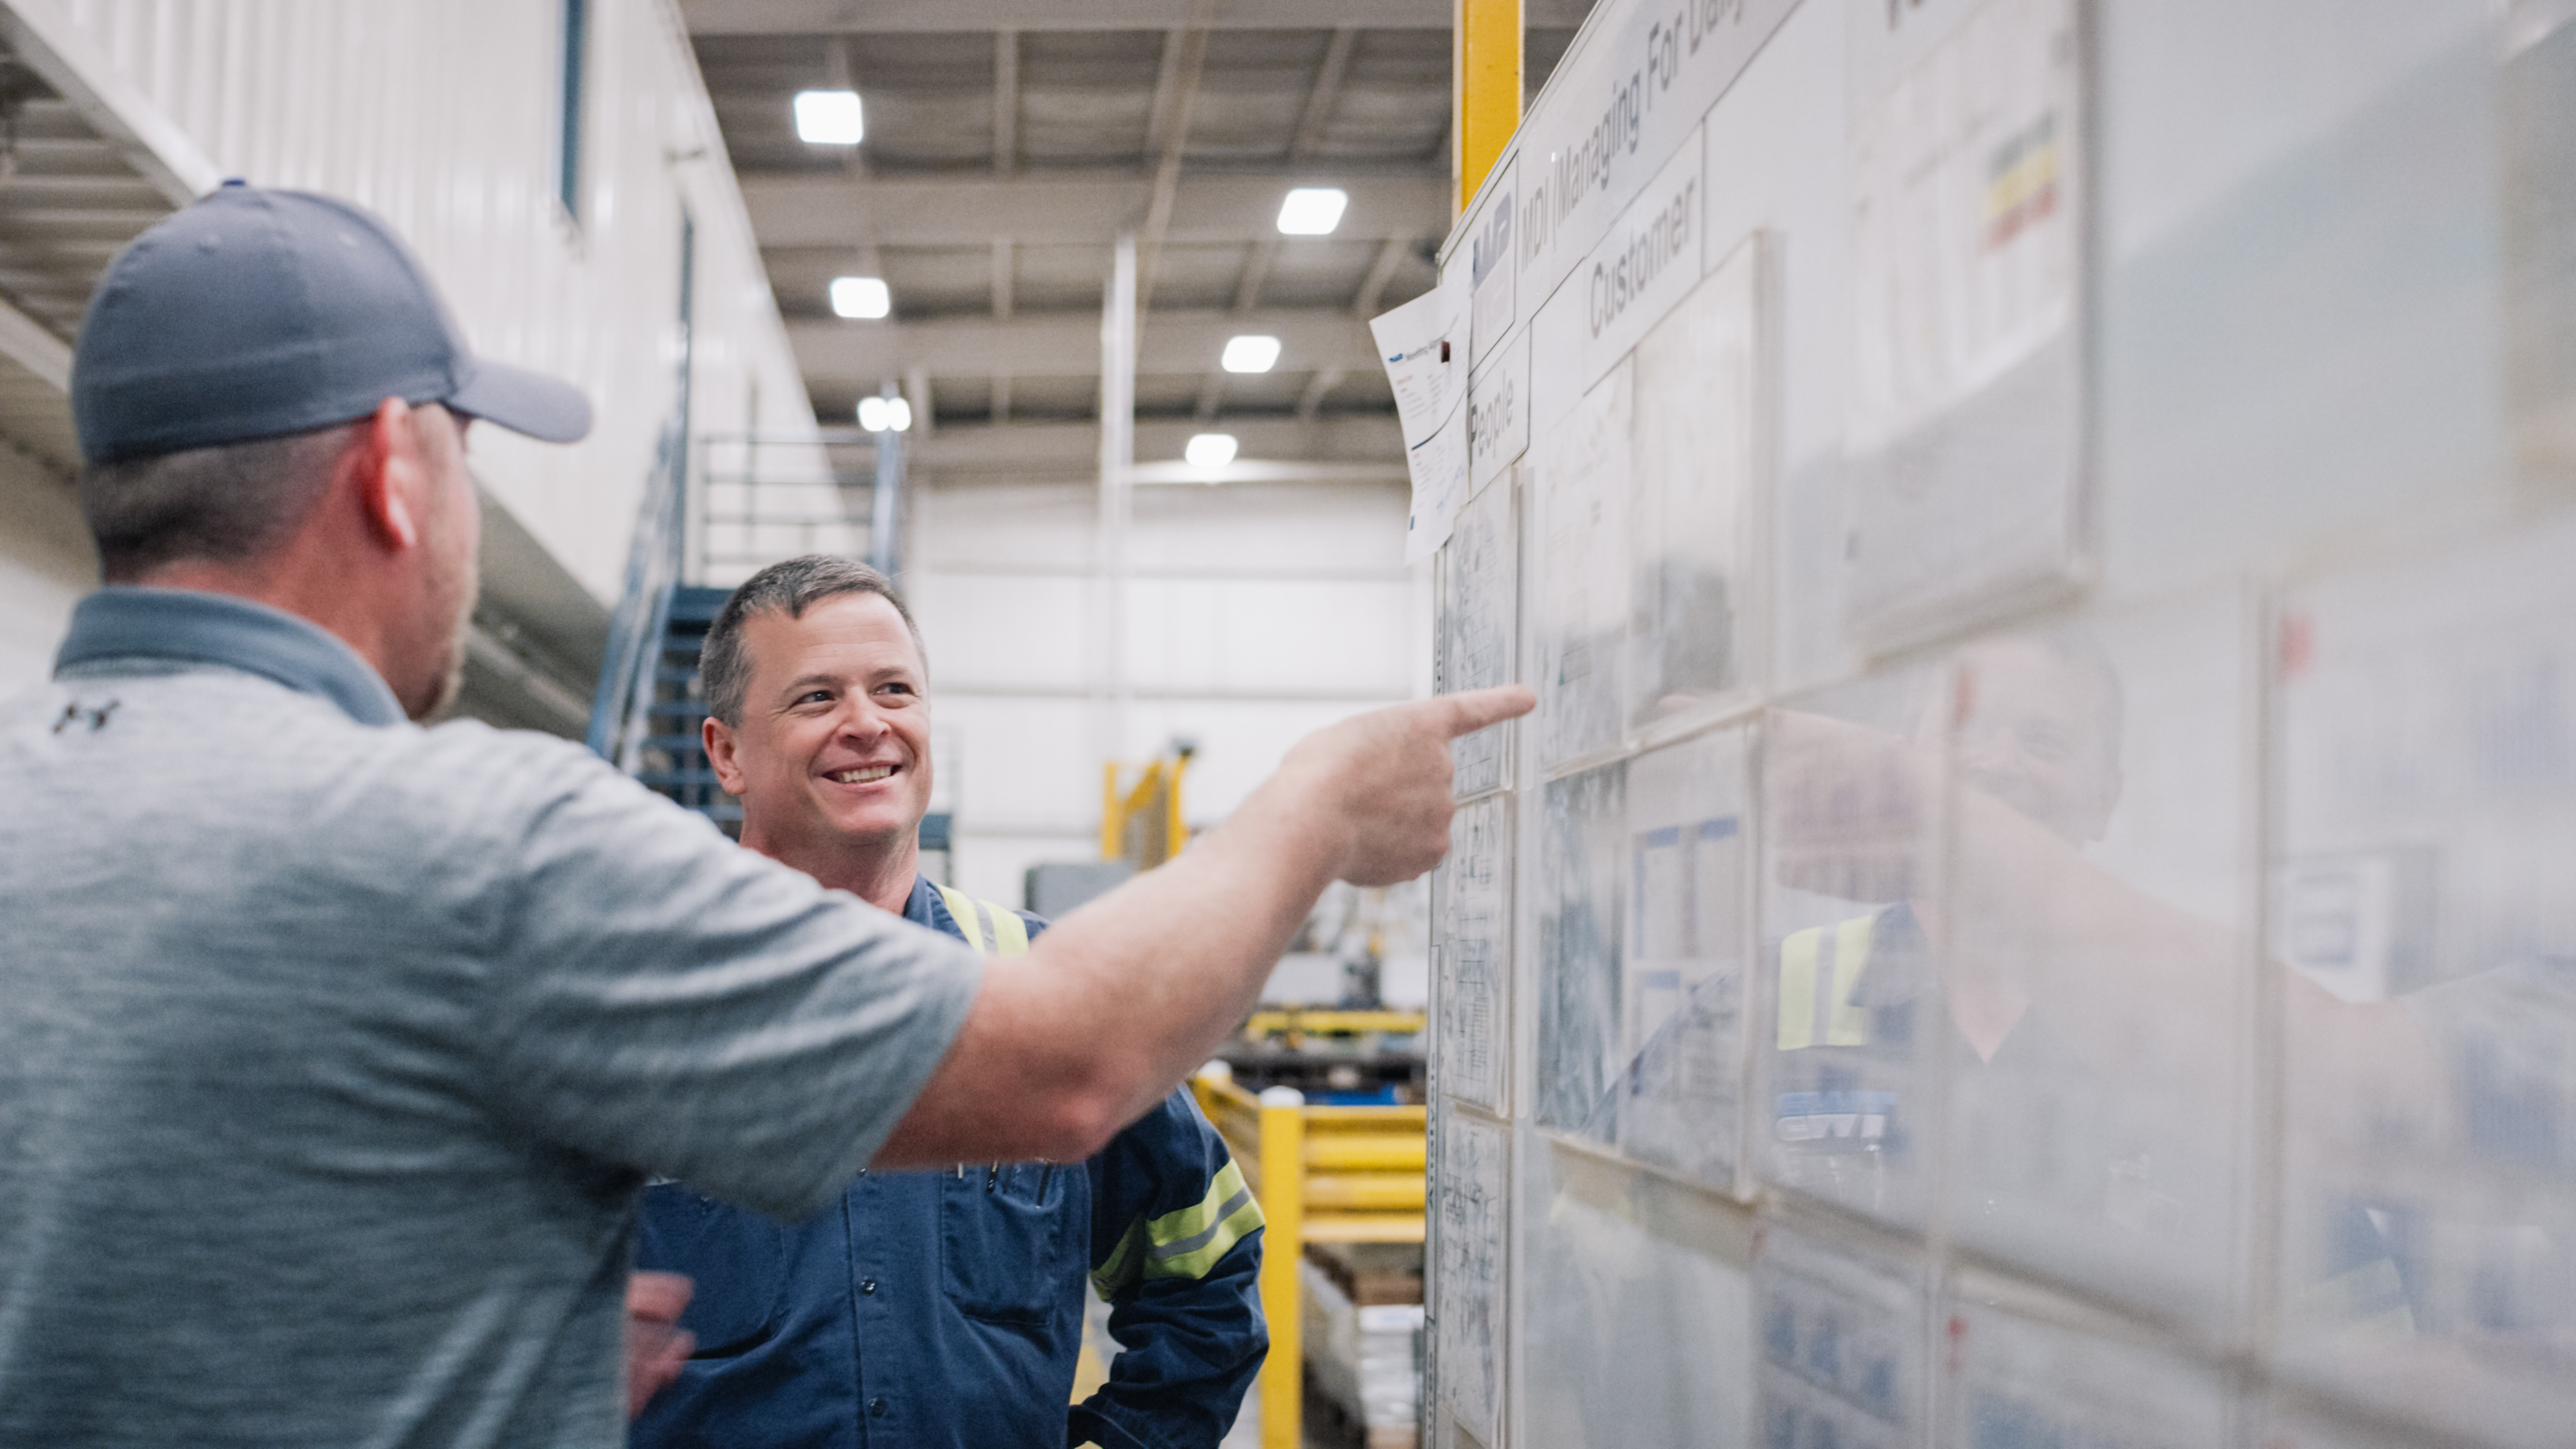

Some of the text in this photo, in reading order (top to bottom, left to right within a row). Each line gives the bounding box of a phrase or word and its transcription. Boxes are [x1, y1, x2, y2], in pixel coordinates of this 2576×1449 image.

[1521, 176, 1549, 274] MDI
[1647, 10, 1683, 112] For
[1590, 176, 1695, 340] Customer
[1471, 369, 1514, 458] People
